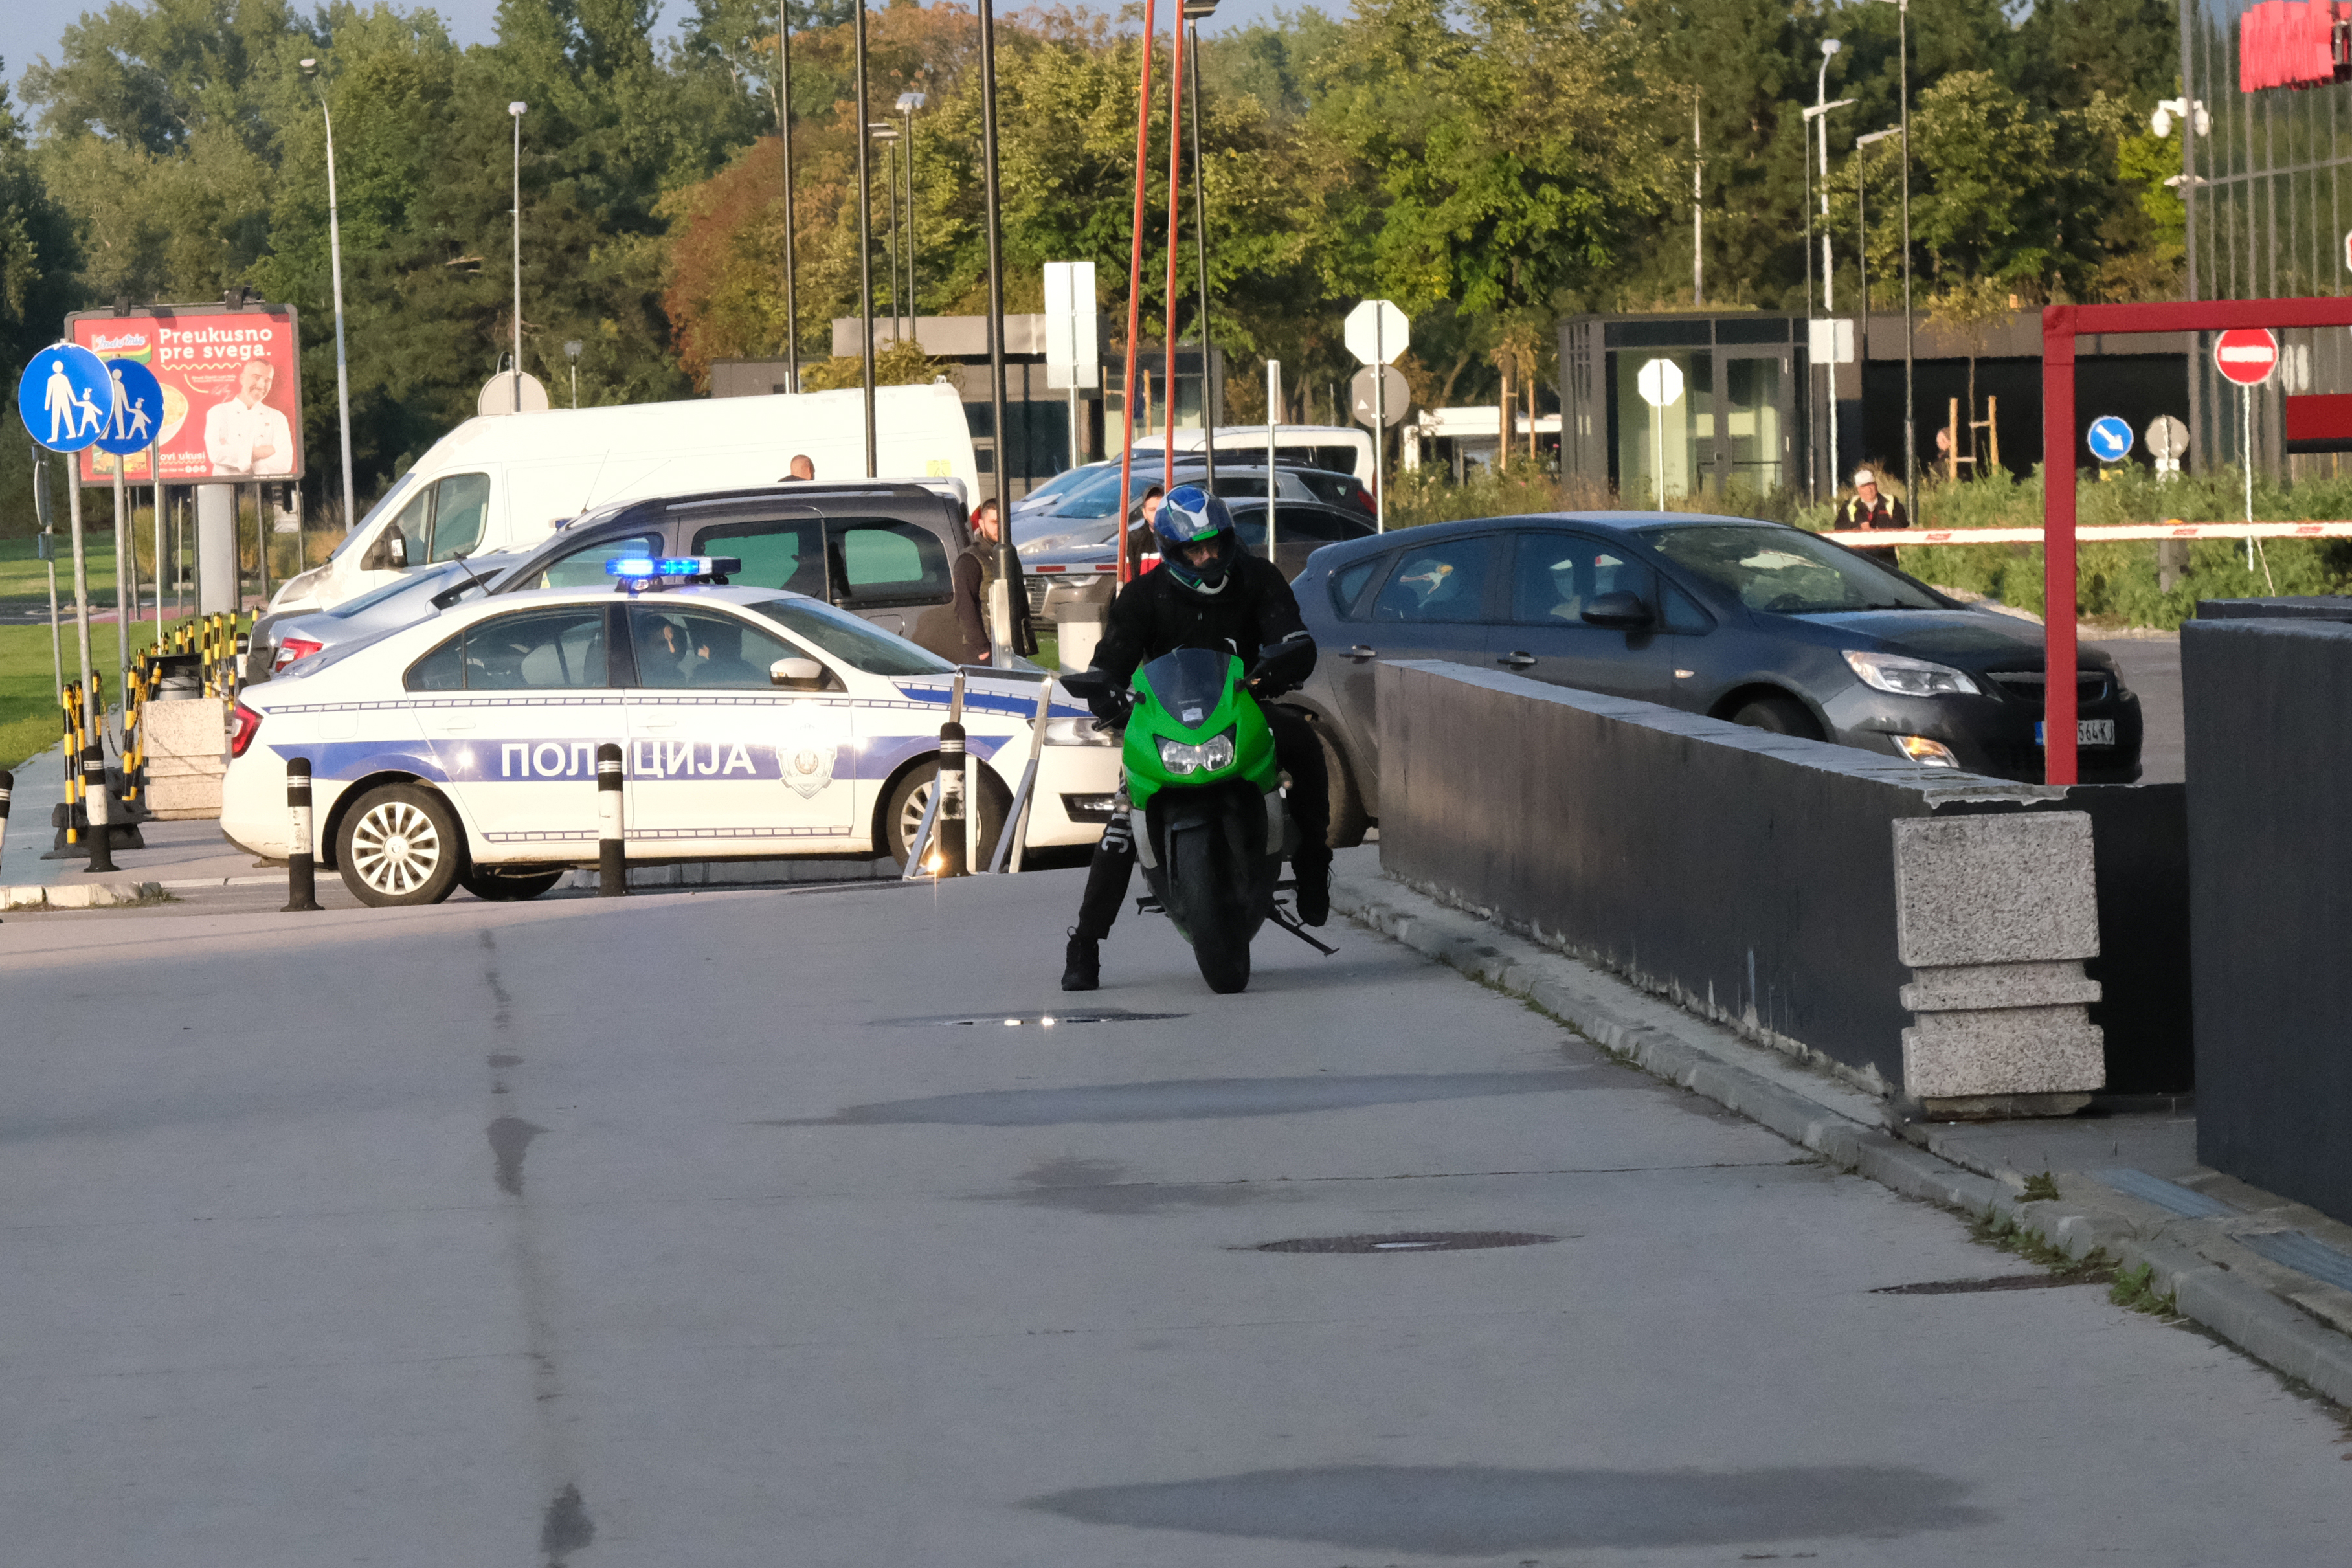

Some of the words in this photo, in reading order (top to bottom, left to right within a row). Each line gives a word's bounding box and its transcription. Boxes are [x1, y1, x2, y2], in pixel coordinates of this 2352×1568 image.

[159, 327, 273, 344] Preukusno
[159, 346, 194, 363] pre
[203, 344, 271, 361] svega.
[159, 452, 175, 461] ovi
[179, 451, 206, 460] ukusi
